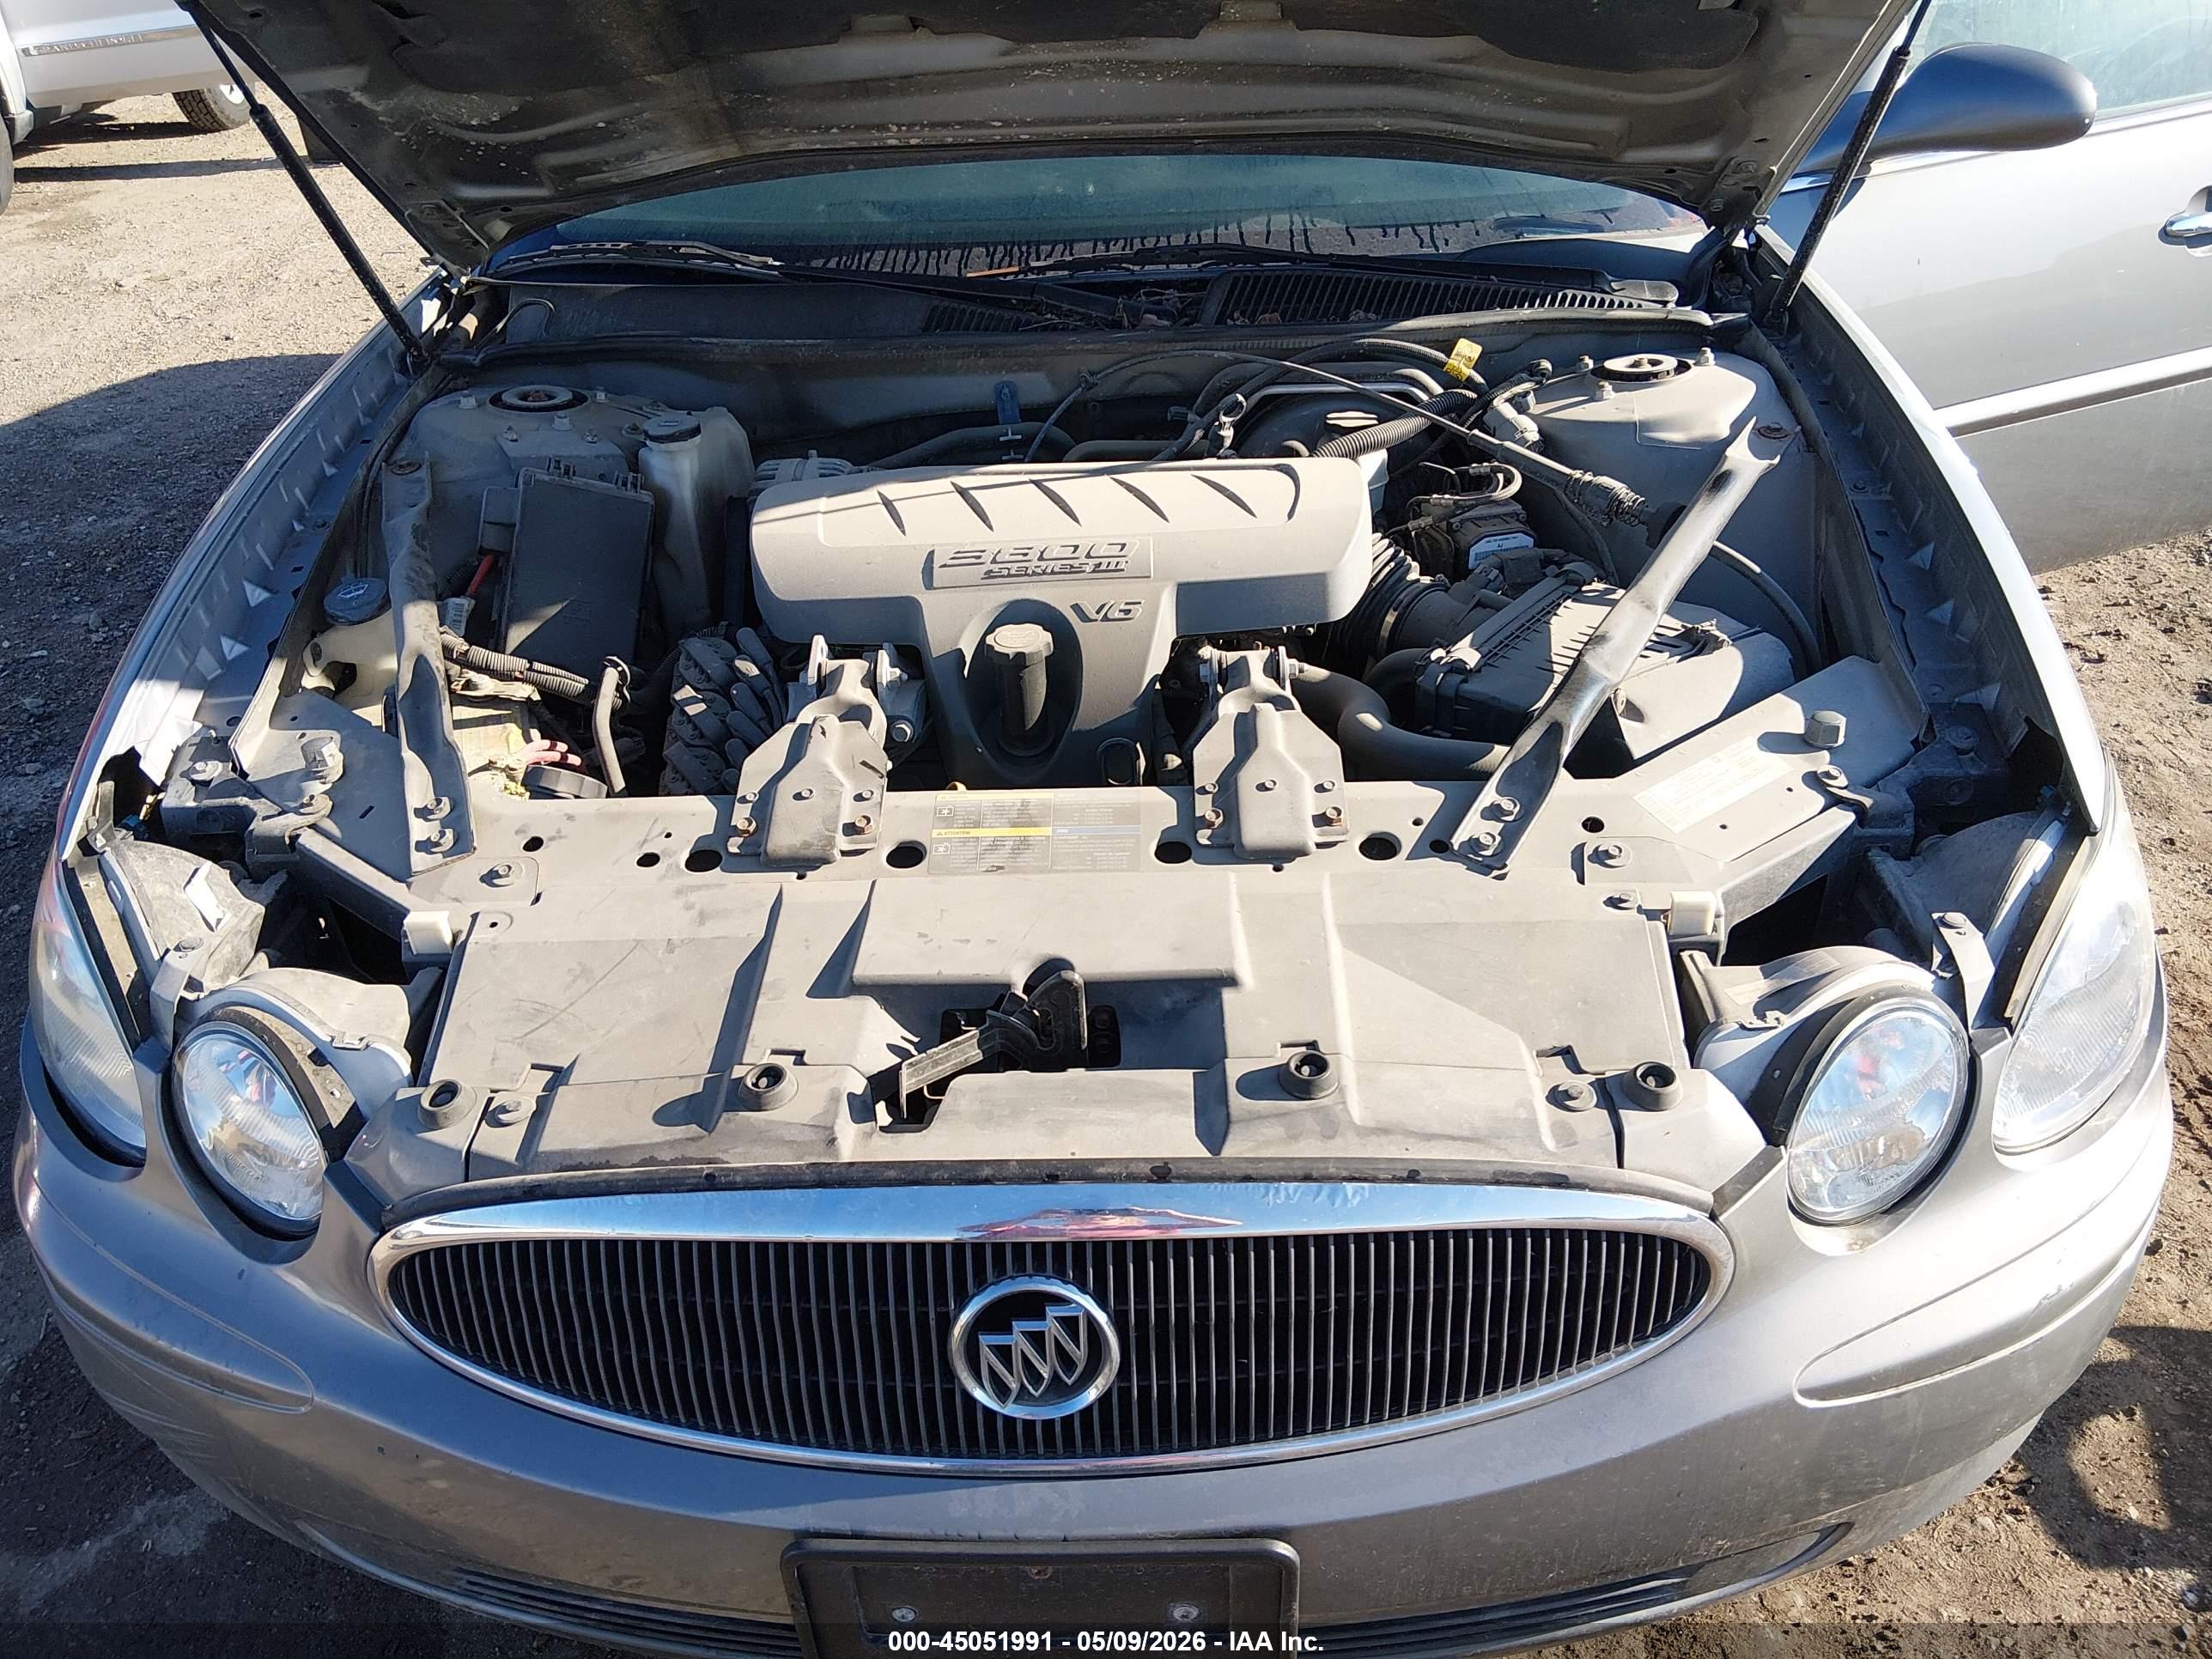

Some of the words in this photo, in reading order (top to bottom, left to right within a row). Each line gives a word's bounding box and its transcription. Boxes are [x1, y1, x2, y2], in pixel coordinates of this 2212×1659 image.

[938, 539, 1139, 568] 3800
[981, 562, 1094, 580] SERIES
[1070, 599, 1144, 623] V6
